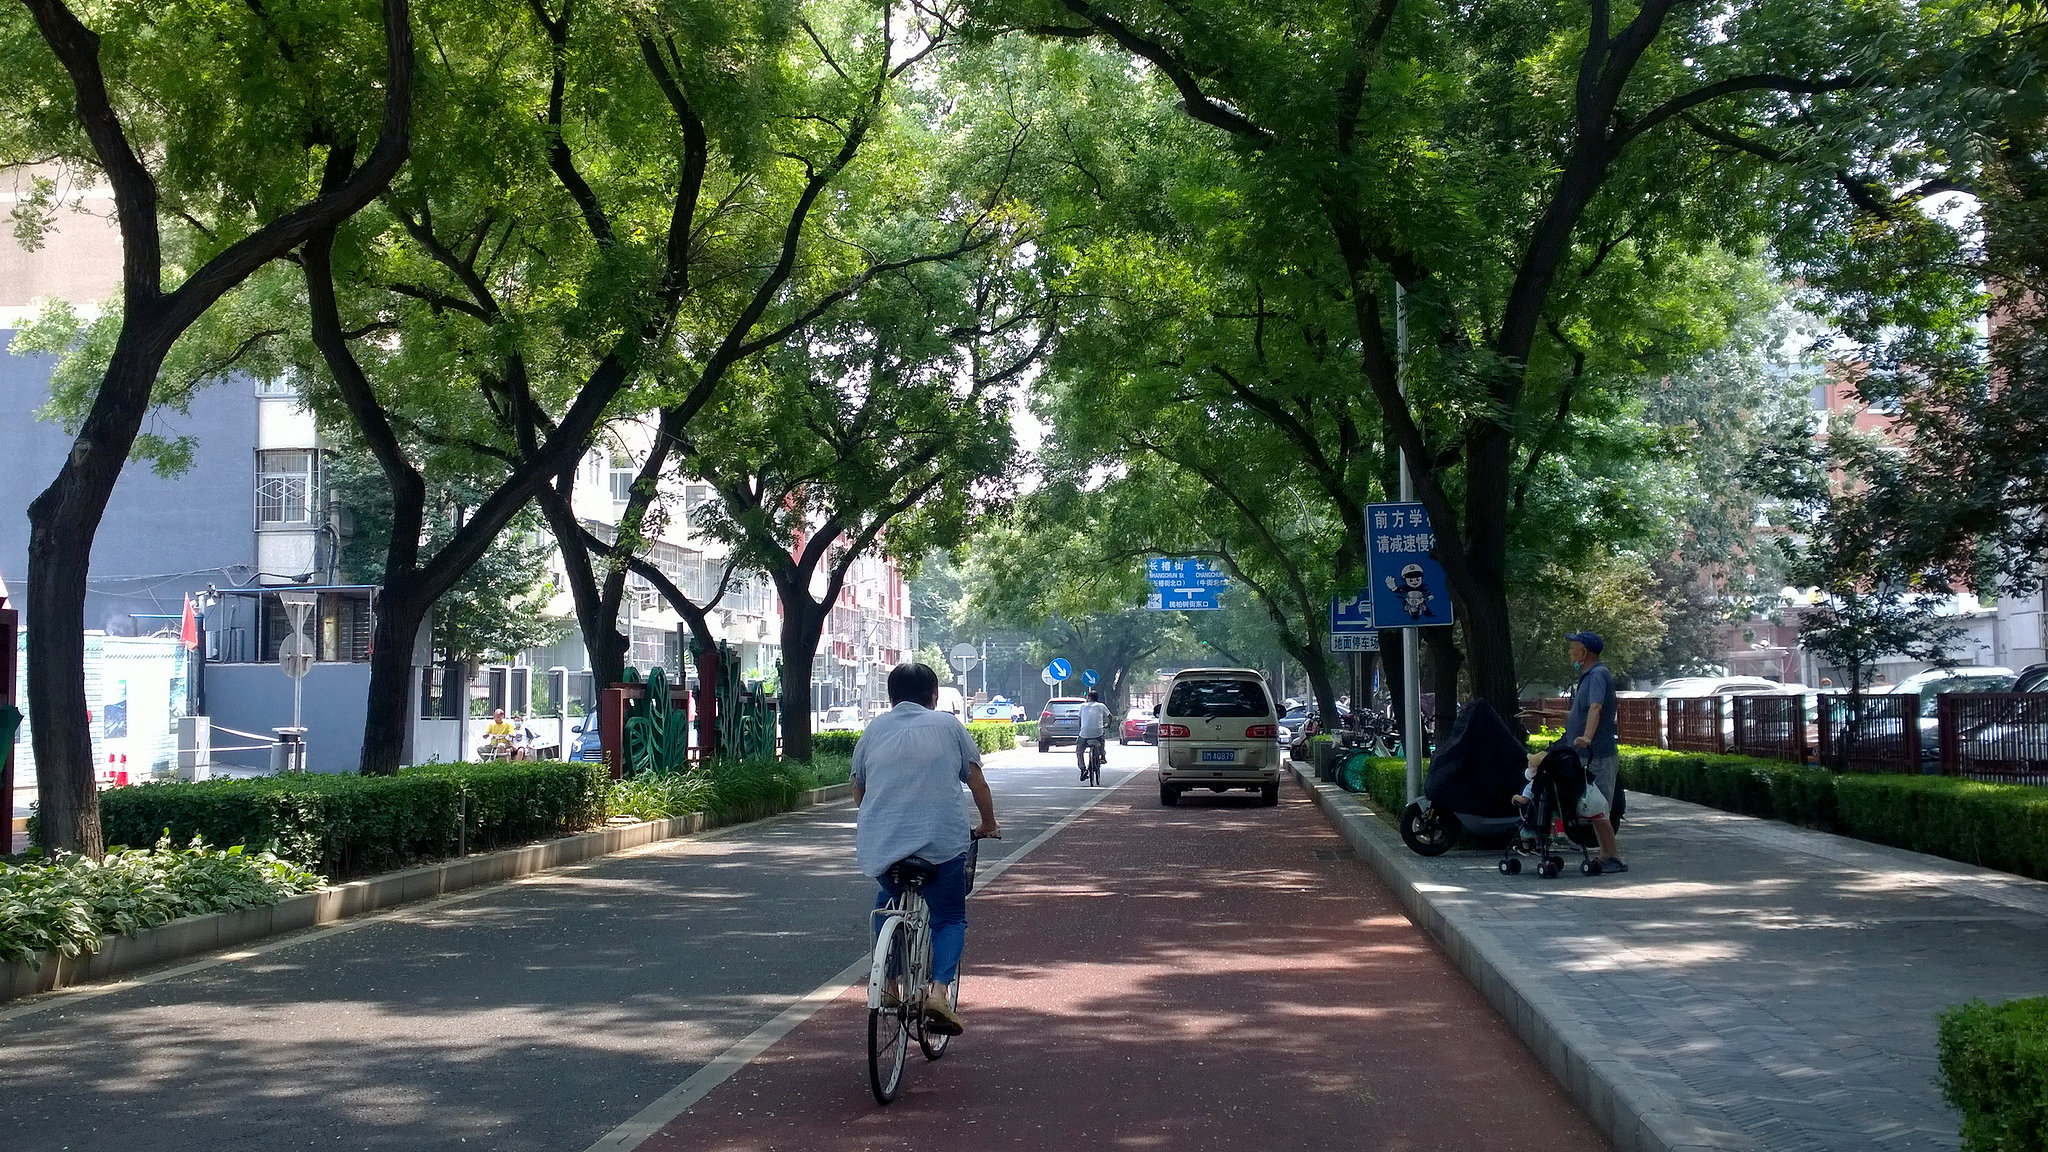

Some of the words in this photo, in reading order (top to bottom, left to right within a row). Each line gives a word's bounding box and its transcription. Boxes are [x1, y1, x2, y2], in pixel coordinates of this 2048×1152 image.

[1375, 509, 1432, 529] 前方学
[1334, 635, 1379, 650] 地面停车场
